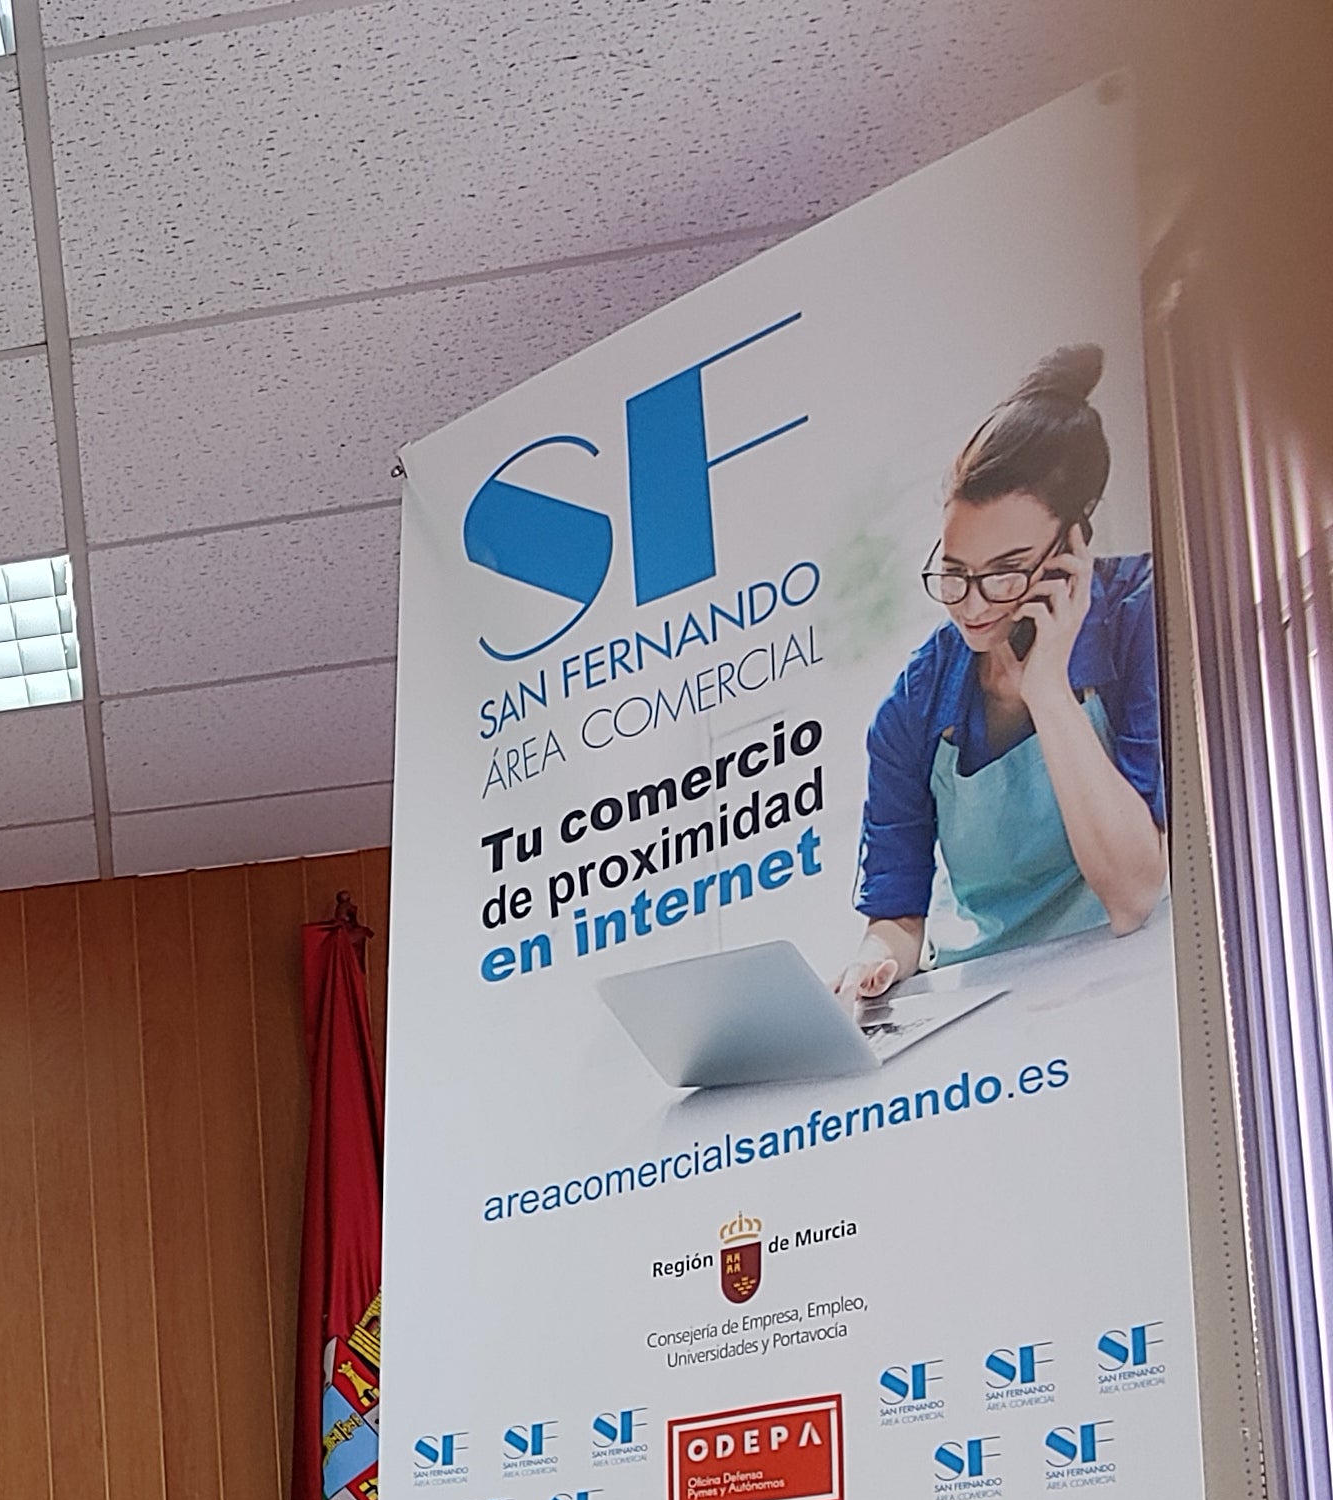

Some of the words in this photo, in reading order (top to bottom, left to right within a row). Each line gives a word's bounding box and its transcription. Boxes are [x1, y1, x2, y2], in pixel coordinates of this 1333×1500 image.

[463, 311, 809, 662] SF
[479, 670, 548, 740] SAN
[562, 561, 821, 699] FERNANDO
[481, 729, 566, 800] ÁREA
[580, 625, 824, 750] COMERCIAL
[480, 826, 542, 874] Tu
[560, 718, 823, 844] comercio
[481, 884, 533, 930] de
[548, 765, 824, 919] proximidad
[480, 932, 553, 983] en
[573, 825, 823, 957] internet
[483, 1057, 1070, 1223] areacomercialsanfernando.es
[646, 1323, 718, 1349] Consejería
[721, 1319, 739, 1336] de
[742, 1308, 803, 1331] Empresa,
[807, 1295, 868, 1320] Empleo,
[652, 1252, 714, 1278] Región
[768, 1236, 790, 1254] de
[795, 1219, 858, 1248] Murcia
[666, 1340, 759, 1368] Universidades
[760, 1338, 769, 1355] y
[773, 1321, 848, 1349] Portavocía
[687, 1421, 823, 1462] ODEPA
[687, 1475, 721, 1489] Oficina
[723, 1470, 763, 1484] Defensa
[687, 1487, 718, 1500] Pymes
[719, 1486, 727, 1497] y
[727, 1478, 785, 1494] Autónomos
